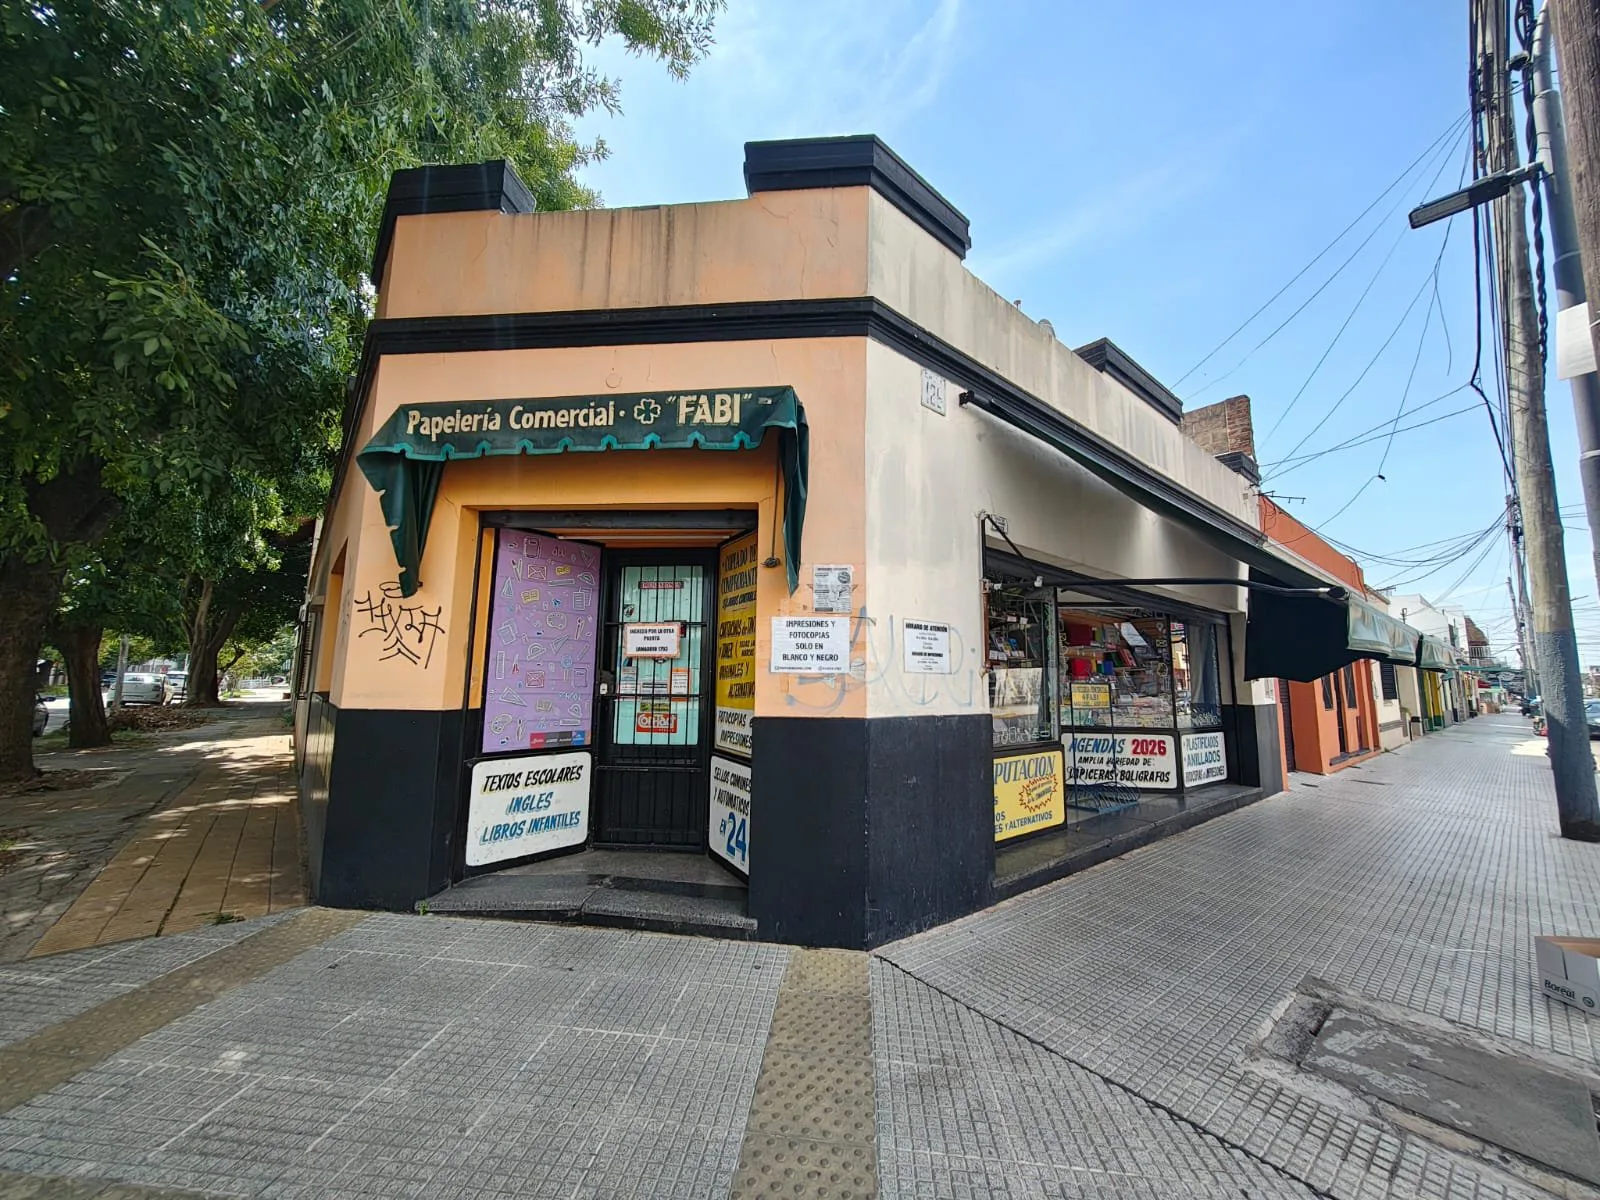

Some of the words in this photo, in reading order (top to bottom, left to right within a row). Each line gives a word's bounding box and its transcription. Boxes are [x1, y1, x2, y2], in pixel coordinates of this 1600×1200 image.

[405, 407, 500, 441] Papelería
[508, 400, 615, 430] Comercial
[786, 620, 828, 628] IMPRESIONES
[831, 620, 836, 628] Y
[796, 642, 812, 650] SOLO
[814, 642, 824, 650] EN
[816, 654, 839, 662] NEGRO
[728, 681, 756, 698] ALTERNATIVO
[718, 710, 746, 727] FOTOCOPIAS
[1068, 737, 1126, 754] AGENDAS
[1131, 738, 1167, 756] 2026
[1078, 756, 1104, 765] AMPLIA
[1187, 750, 1220, 767] ANILLADOS
[482, 771, 523, 793] TEXTOS
[524, 765, 584, 787] ESCOLARES
[994, 755, 1056, 785] PUTACION
[1120, 770, 1170, 782] BOLIGRAFOS
[507, 791, 554, 814] INGLES
[994, 824, 1002, 834] ES
[1008, 810, 1053, 829] ALTERNATIVOS
[996, 811, 1006, 822] OS
[481, 820, 527, 843] LIBROS
[528, 811, 581, 834] INFANTILES
[726, 812, 747, 863] 24
[1544, 979, 1576, 1000] Boreal
